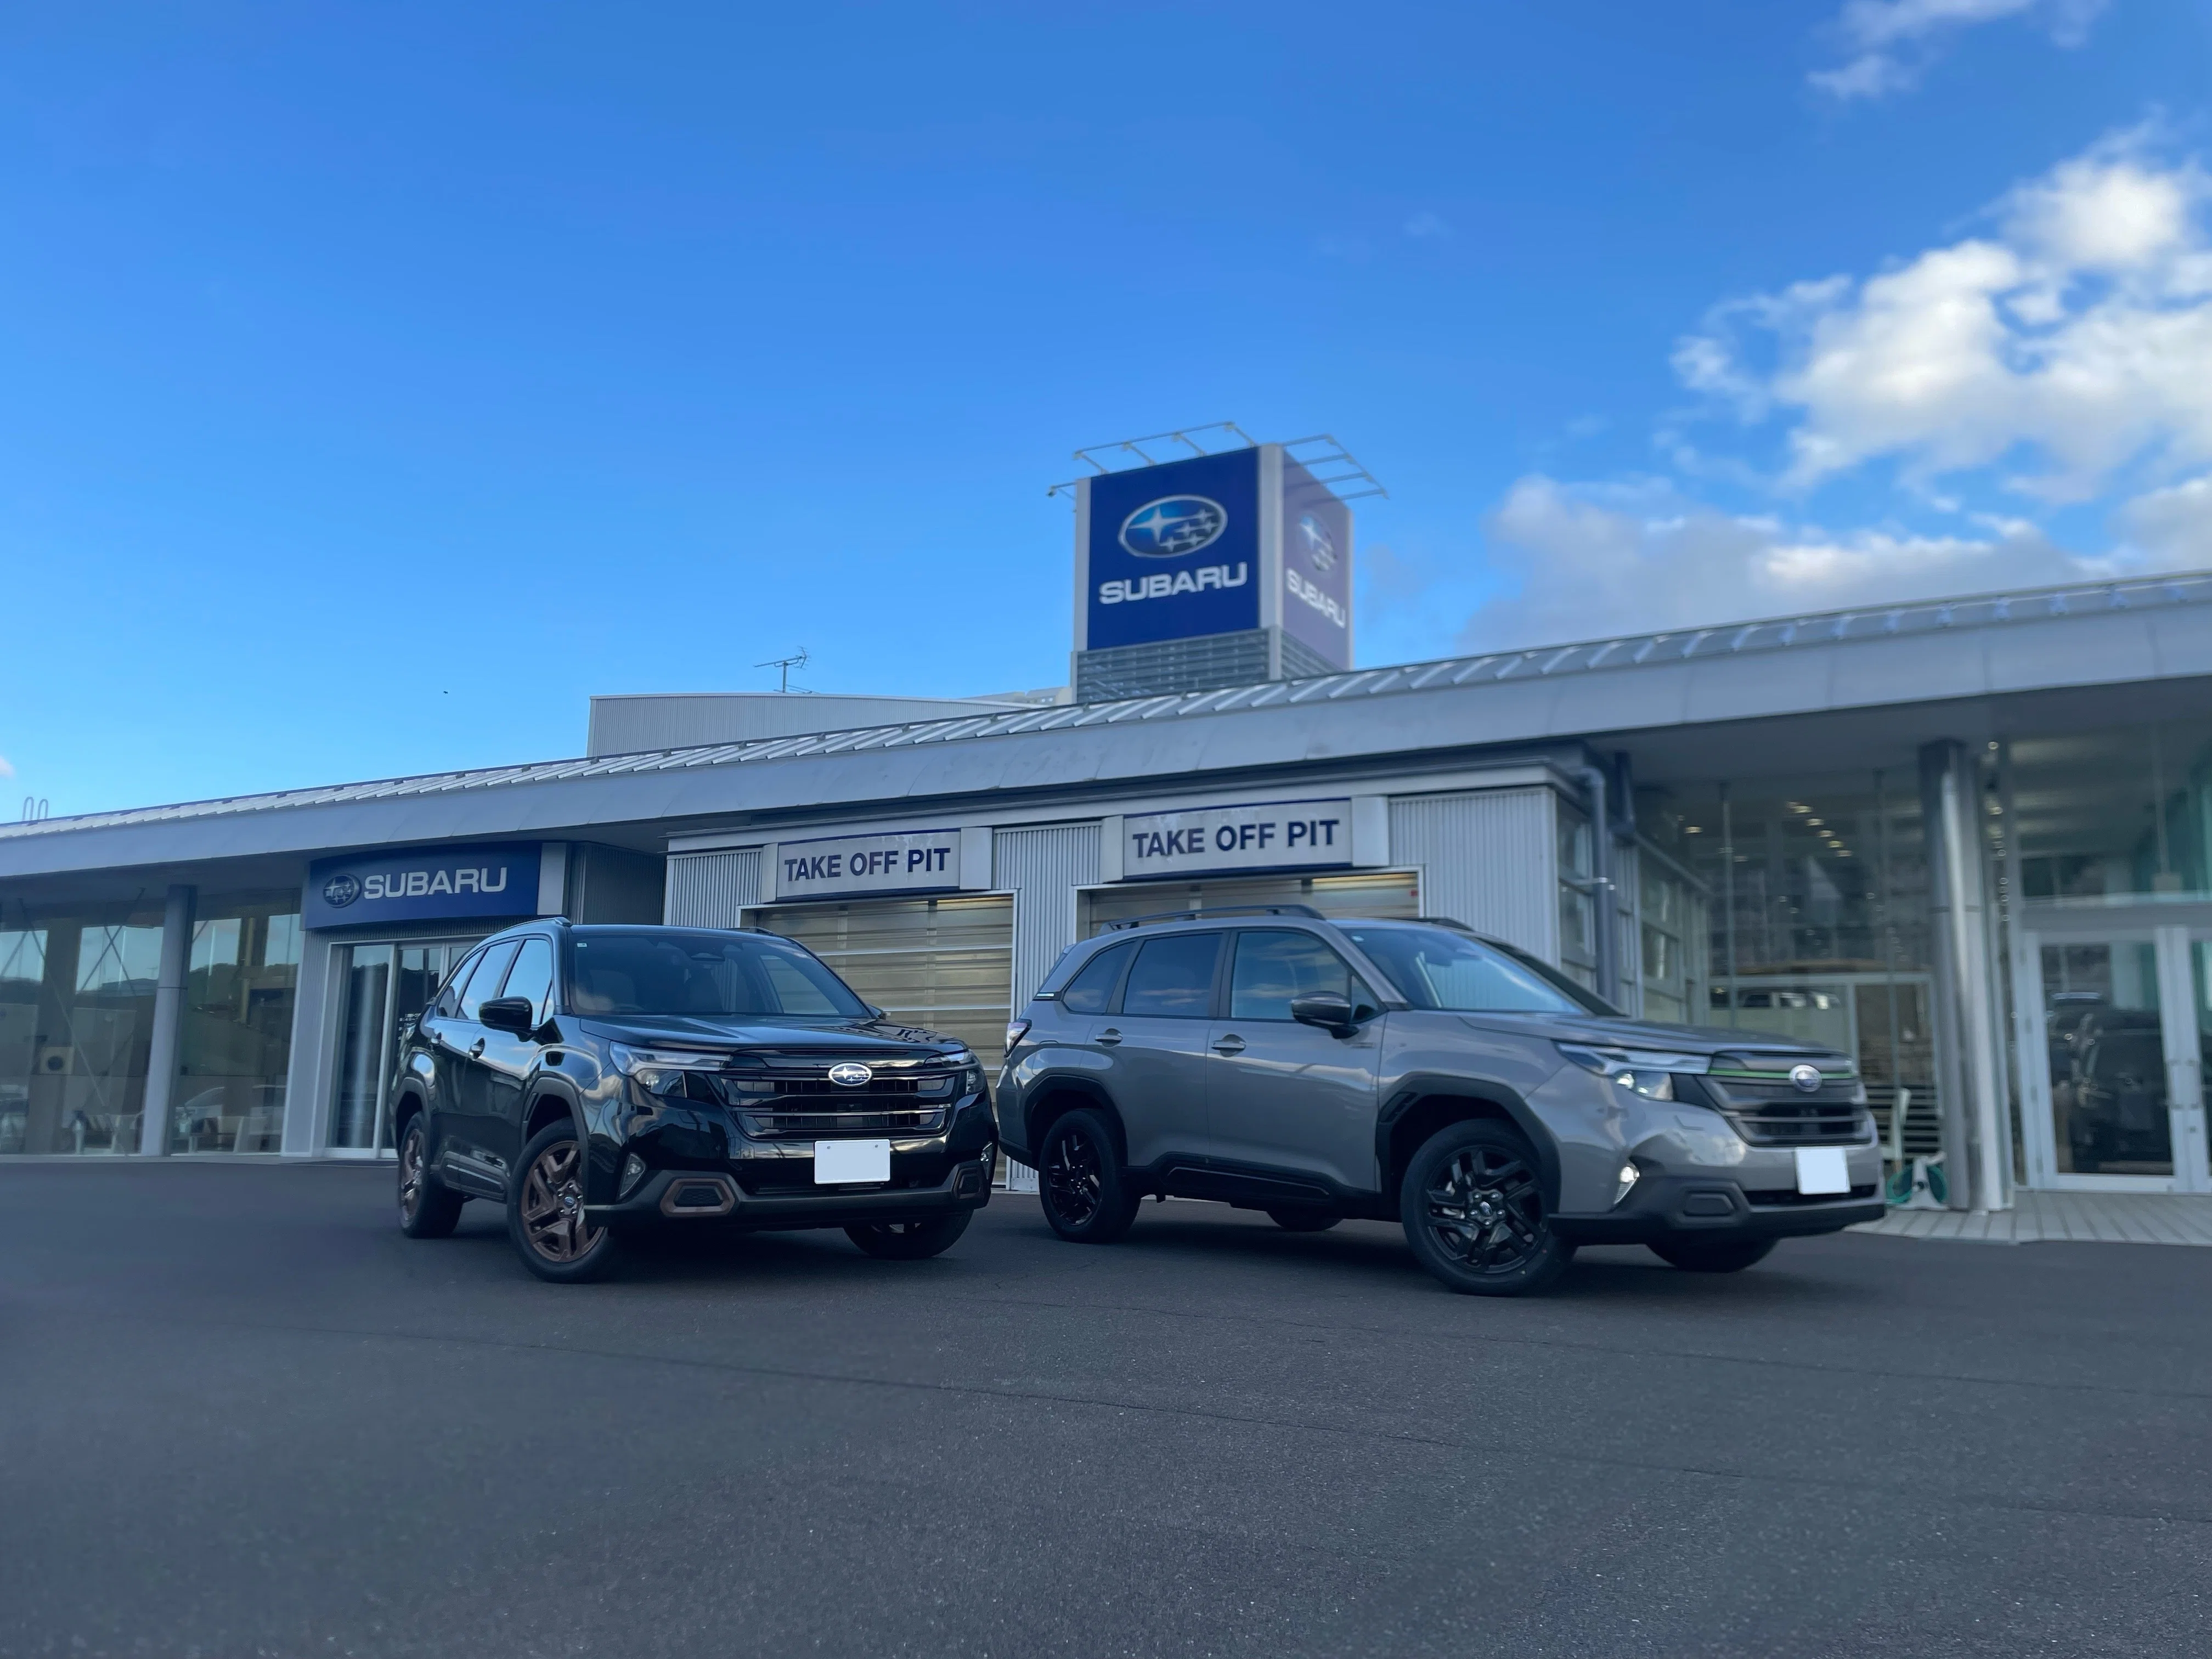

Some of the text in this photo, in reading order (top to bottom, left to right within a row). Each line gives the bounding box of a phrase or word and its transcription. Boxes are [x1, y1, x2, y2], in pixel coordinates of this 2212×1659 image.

[1099, 562, 1247, 604] SUBARU
[1286, 568, 1346, 628] SUBARU
[1132, 819, 1340, 858] TAKE OFF PIT
[364, 867, 507, 900] SUBARU
[785, 848, 951, 882] TAKE OFF PIT
